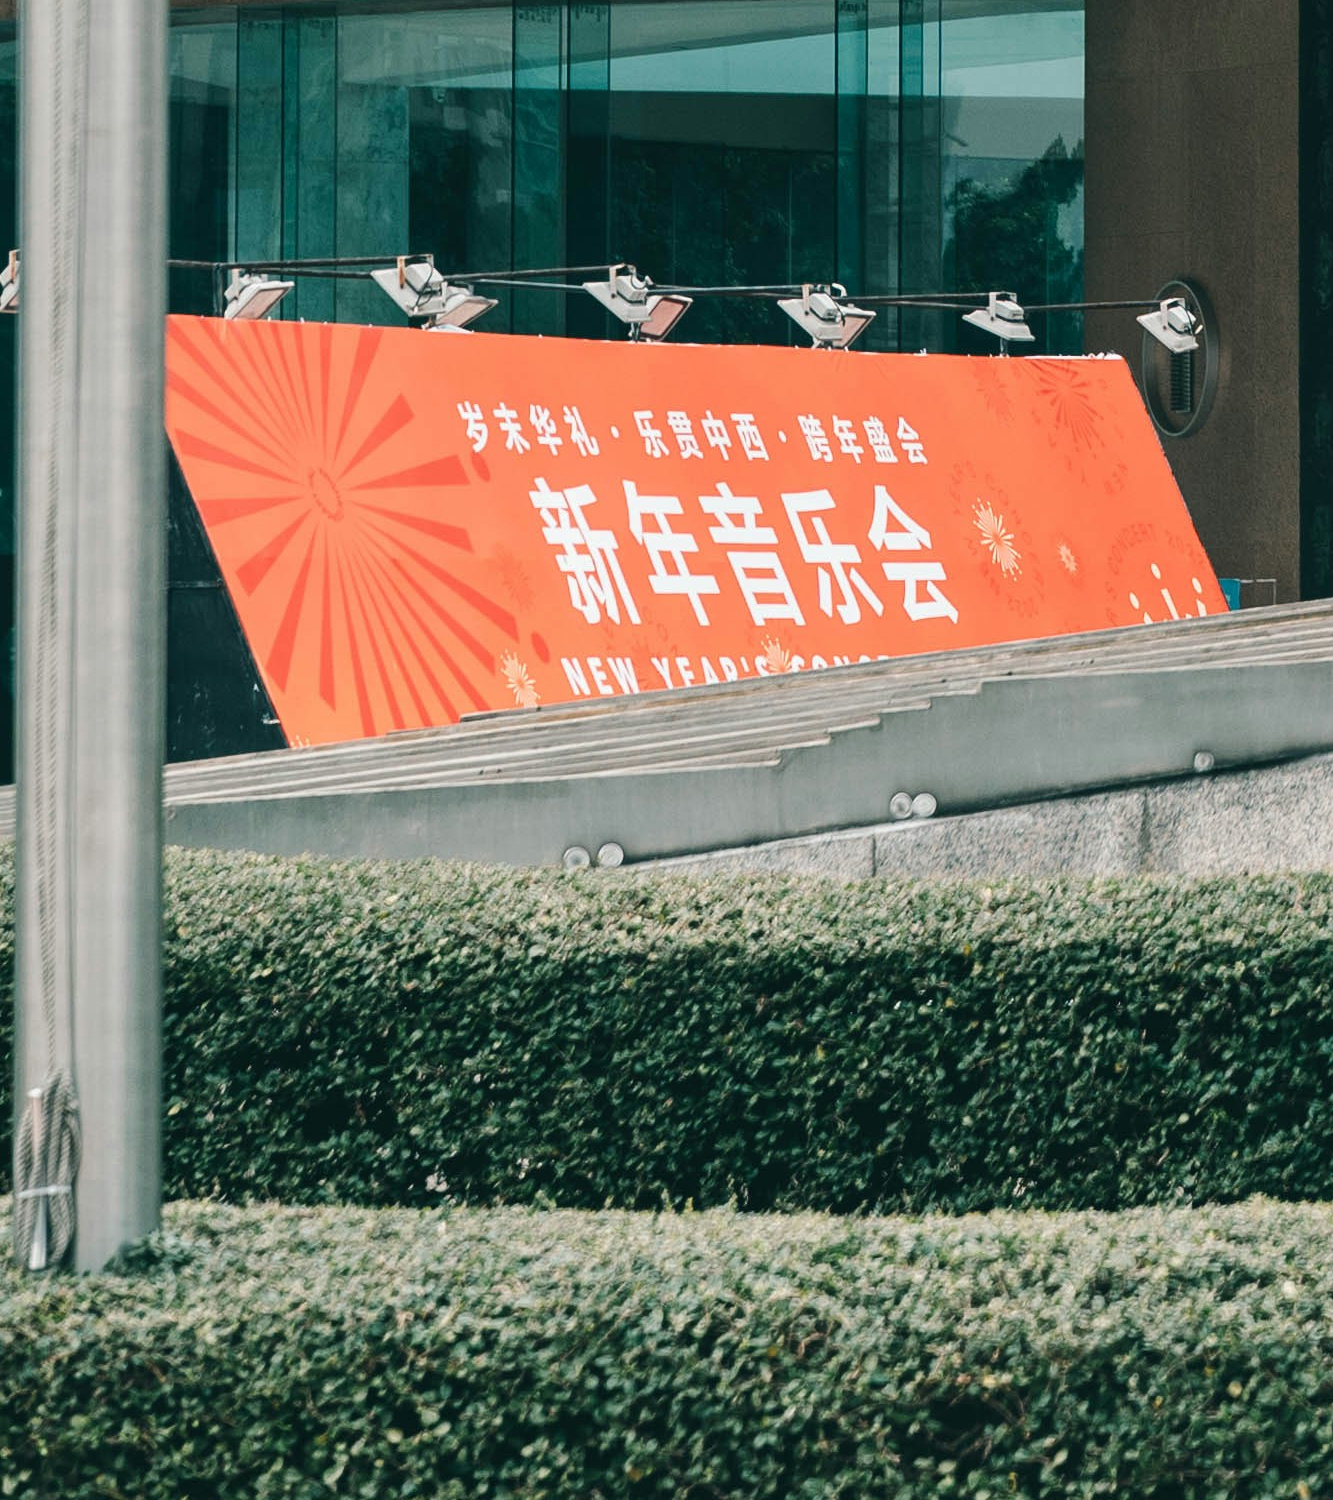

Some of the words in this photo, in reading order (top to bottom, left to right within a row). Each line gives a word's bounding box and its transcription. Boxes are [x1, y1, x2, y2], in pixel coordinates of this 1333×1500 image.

[529, 478, 958, 626] 新年音乐会
[561, 657, 640, 695] NEW
